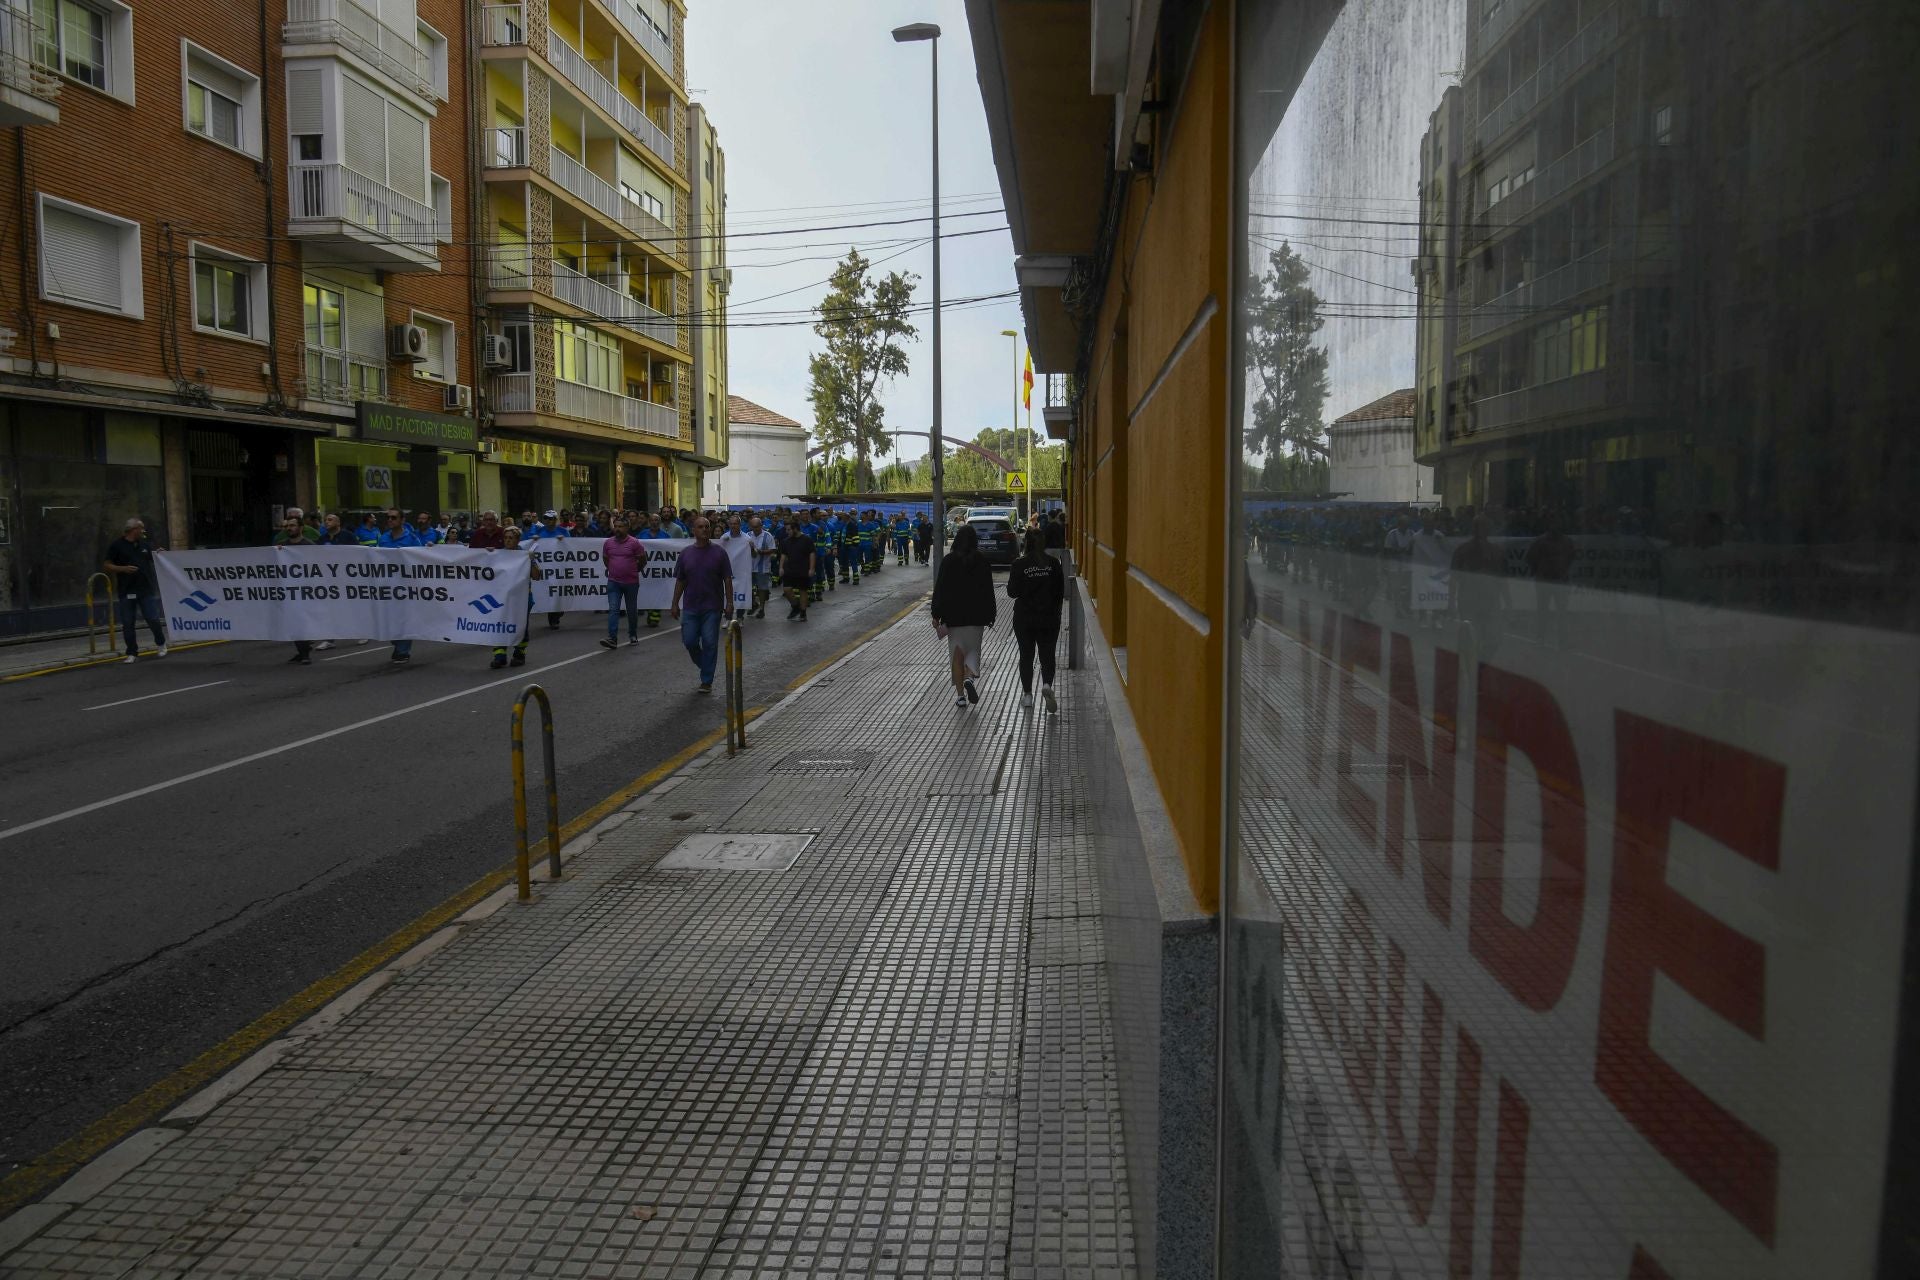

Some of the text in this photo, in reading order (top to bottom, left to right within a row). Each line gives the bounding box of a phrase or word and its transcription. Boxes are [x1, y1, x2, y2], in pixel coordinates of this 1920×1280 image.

[369, 413, 473, 441] MAD FACTORY DESIGN
[532, 550, 599, 563] REGADO
[183, 564, 495, 582] TRANSPARENCIA Y CUMPLIMIENTO
[538, 567, 574, 581] PLE
[579, 567, 600, 579] EL
[222, 585, 455, 602] DE NUESTROS DERECHOS.
[548, 584, 609, 597] FIRMAD
[172, 617, 231, 632] Navantia
[457, 617, 516, 635] Navantia
[1299, 600, 1787, 1249] VENDE
